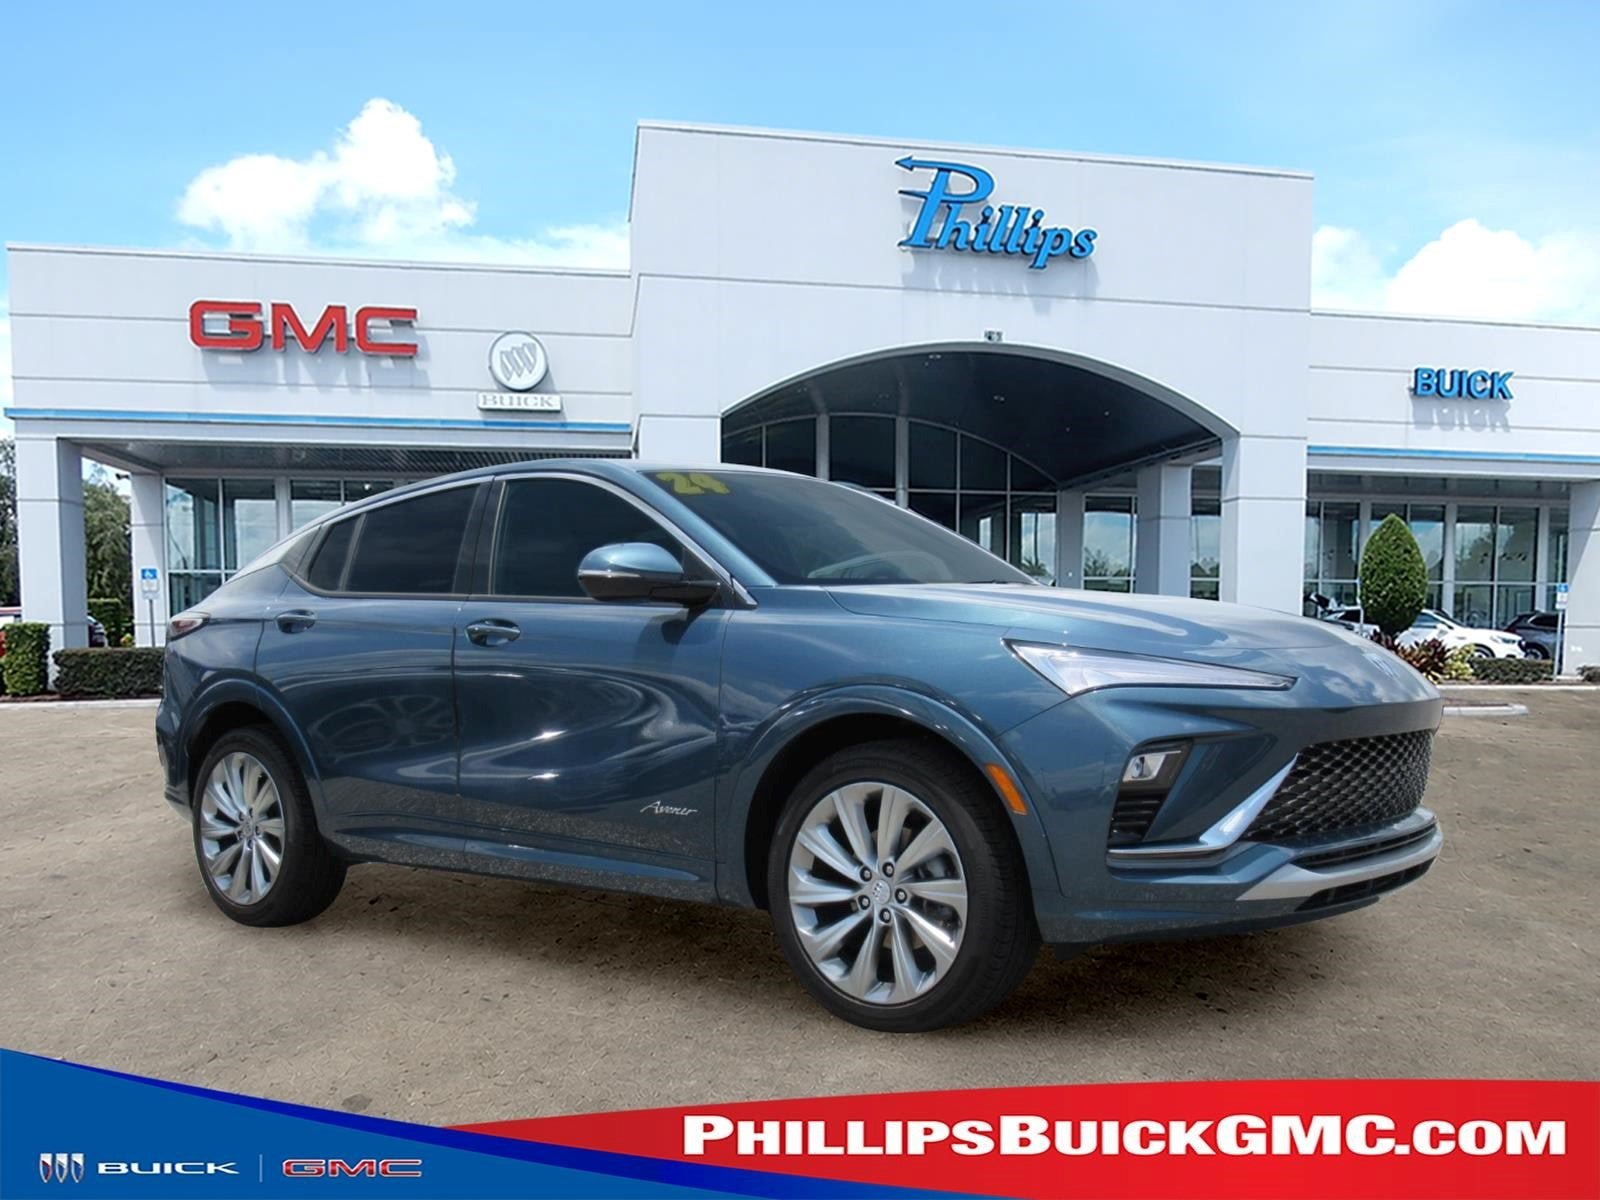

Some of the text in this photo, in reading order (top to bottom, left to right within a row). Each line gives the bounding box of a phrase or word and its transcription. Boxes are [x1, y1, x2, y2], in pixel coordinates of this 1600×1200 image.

[895, 155, 1098, 270] Phillips
[189, 300, 418, 357] GMC
[482, 394, 554, 407] BUICK
[1414, 367, 1514, 400] BUICK
